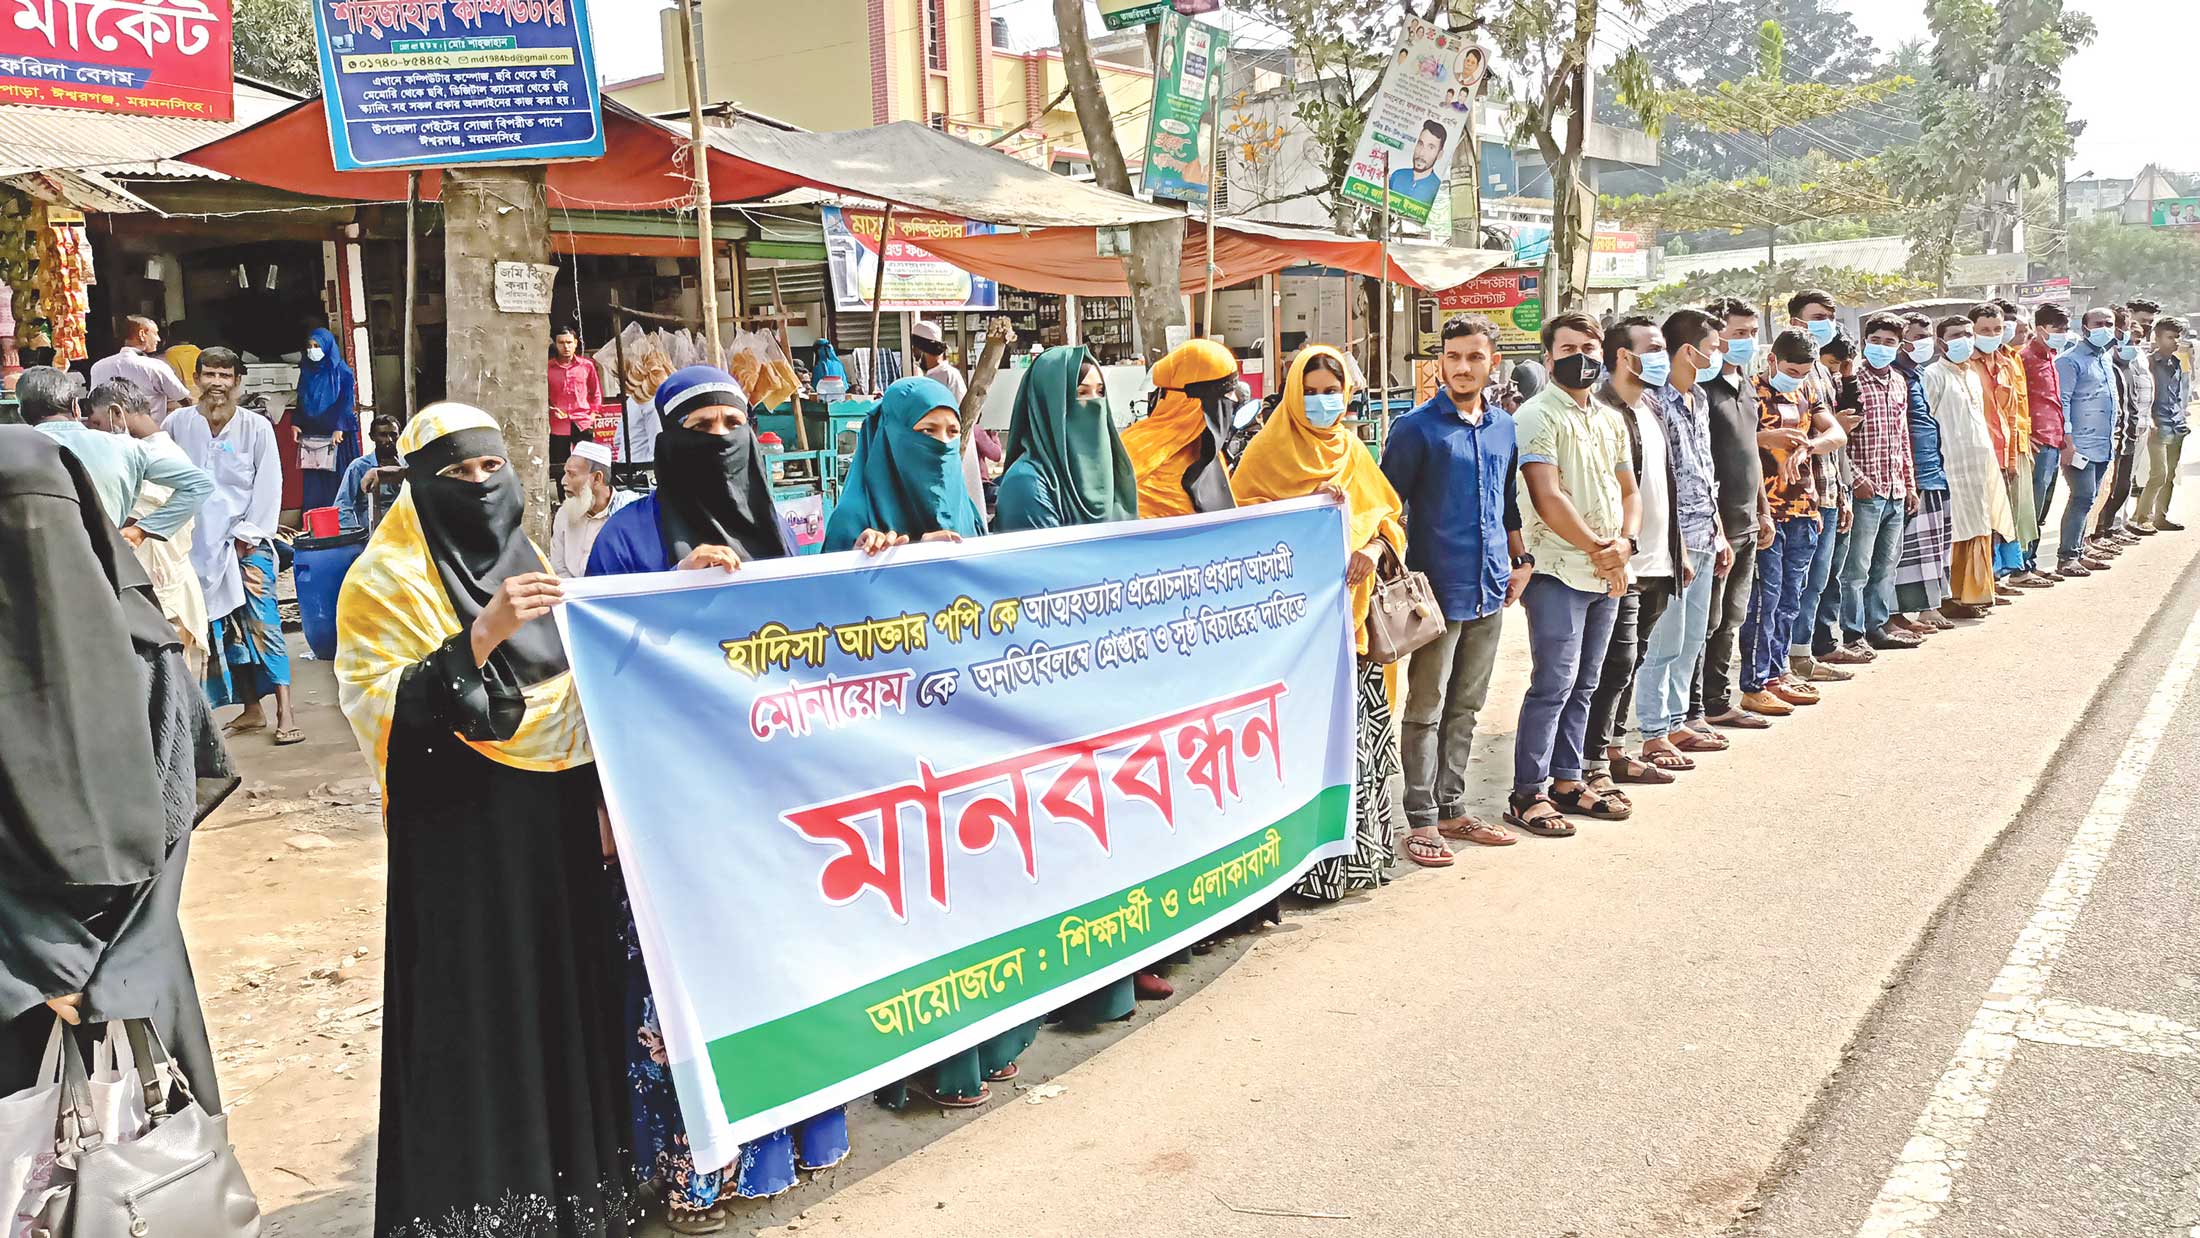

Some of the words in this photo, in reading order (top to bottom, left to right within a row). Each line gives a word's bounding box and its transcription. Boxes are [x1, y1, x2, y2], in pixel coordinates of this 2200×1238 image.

[470, 54, 569, 64] md1984bd@gmail.com
[76, 67, 135, 87] বেগম
[372, 75, 402, 86] এখানে
[404, 72, 451, 86] কম্পিউটার
[495, 69, 511, 81] ছবি
[514, 71, 537, 81] থেকে
[540, 68, 556, 80] ছবি
[363, 88, 397, 100] মেমোরি
[401, 90, 424, 99] থেকে
[426, 86, 447, 98] ছবি,
[449, 85, 487, 97] ডিজিটাল
[489, 85, 524, 95] ক্যামেরা
[527, 83, 550, 93] থেকে
[552, 80, 569, 93] ছবি
[392, 104, 408, 112] সহ
[409, 102, 432, 111] সকল
[434, 101, 461, 111] প্রকার
[463, 98, 511, 110] অনলাইনের
[513, 98, 533, 107] কাজ
[536, 97, 554, 106] করা
[371, 123, 417, 135] উপজেলা
[420, 122, 460, 133] গেইটের
[463, 119, 493, 131] সোজা
[496, 116, 534, 130] বিপরীত
[538, 116, 563, 128] পাশে
[468, 131, 523, 145] ময়মনসিংহ
[900, 218, 963, 238] কম্পিউটার
[1466, 276, 1517, 290] কম্পিউটার
[720, 620, 829, 678] হাদিসা
[832, 611, 928, 660] আক্তার
[931, 594, 984, 643] পপি
[988, 597, 1020, 634] কে
[1022, 578, 1123, 627] আত্মহত্যার
[1126, 564, 1202, 607] প্ররোচনায়
[1203, 555, 1244, 591] প্রধান
[1244, 542, 1293, 583] আসামী
[750, 668, 914, 740] মোনায়েম
[918, 669, 960, 705] কে
[968, 639, 1091, 697] অনতিবিলম্বে
[1094, 626, 1149, 669] গ্রেপ্তার
[1151, 624, 1169, 653] ও
[1200, 603, 1258, 644] বিচারের
[1256, 590, 1307, 629] দাবিতে
[780, 679, 1290, 925] মানববন্ধন
[866, 946, 1026, 1037] আয়োজনে
[1056, 885, 1152, 966] শিক্ষার্থী
[1160, 889, 1179, 918] ও
[1187, 828, 1282, 906] এলাকাবাসী
